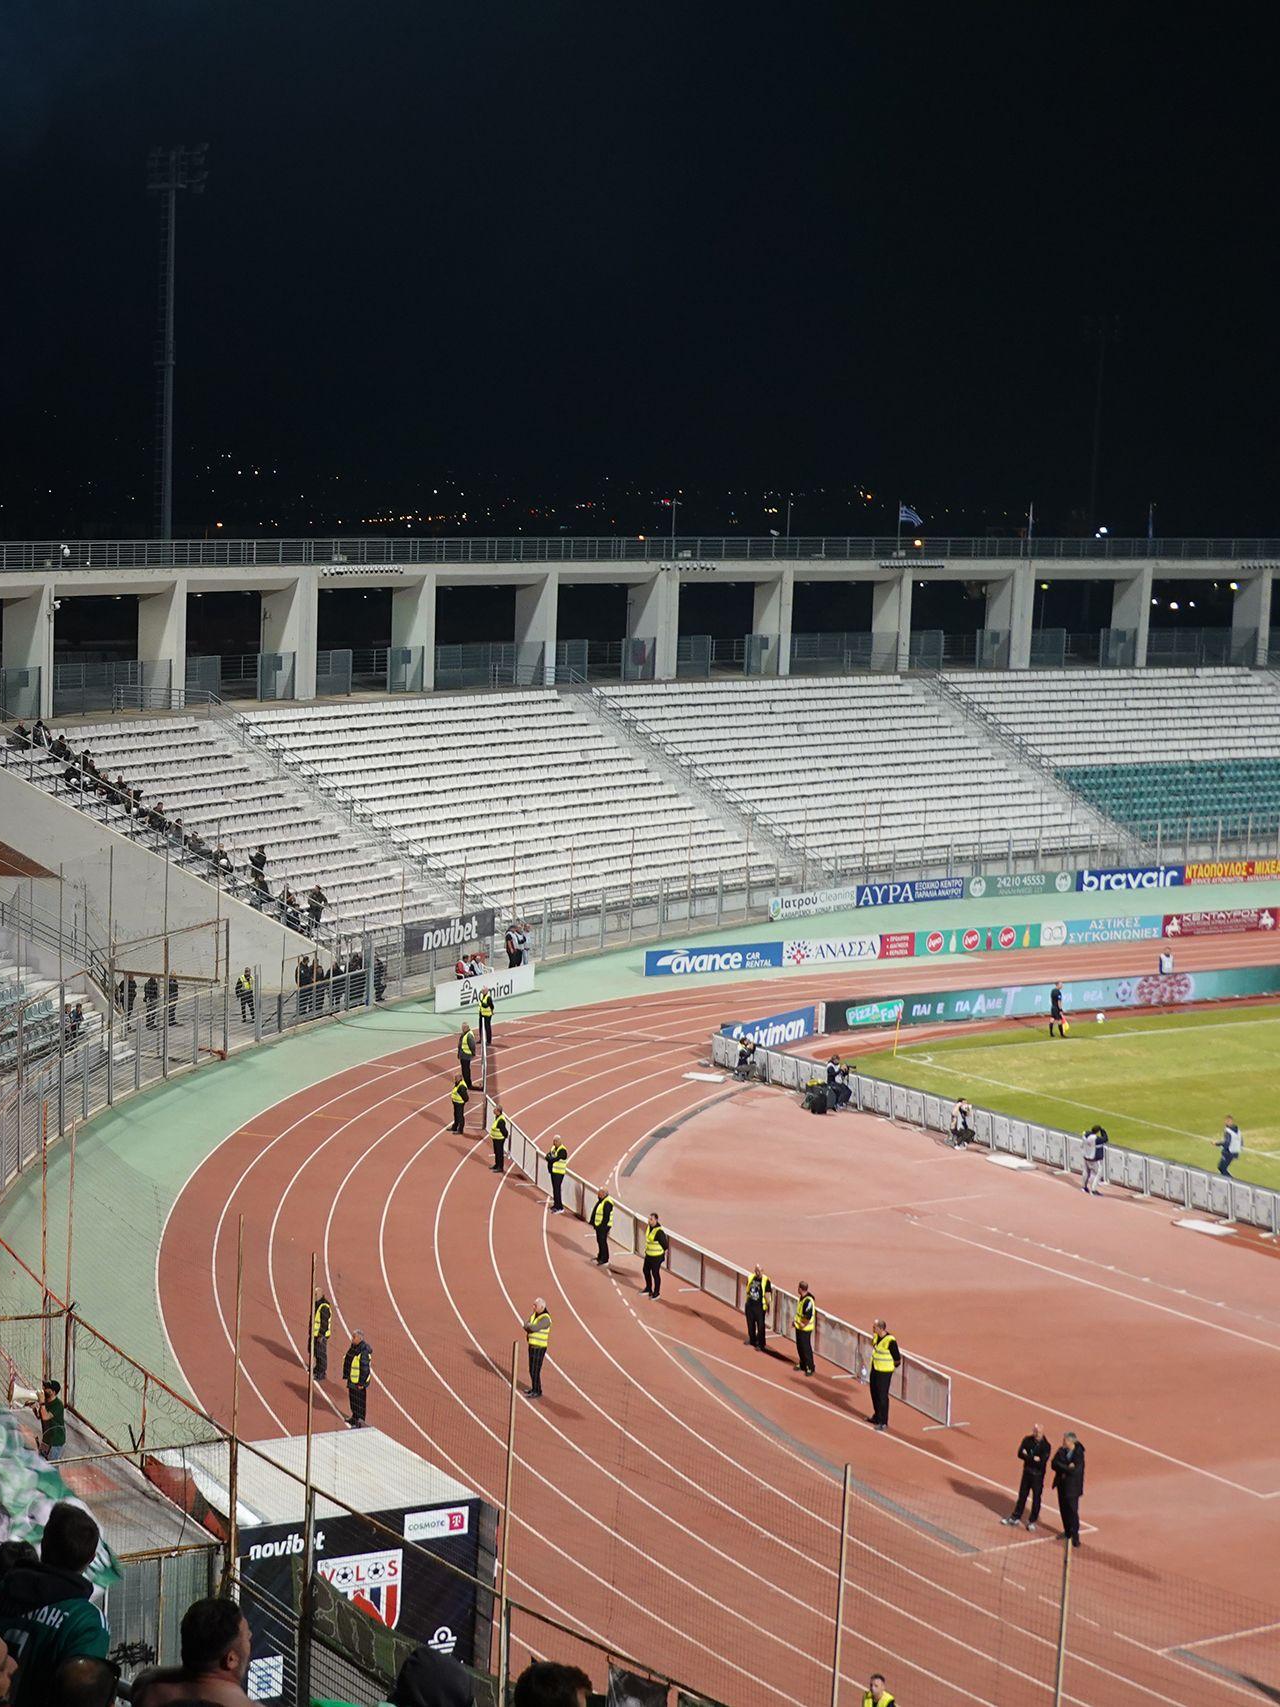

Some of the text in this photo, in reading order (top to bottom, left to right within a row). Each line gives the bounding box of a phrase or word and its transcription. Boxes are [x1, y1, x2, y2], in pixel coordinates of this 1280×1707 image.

[940, 878, 963, 888] ΚΕΝΤΡΟ
[997, 876, 1020, 888] 24210
[1082, 865, 1178, 891] bravair
[780, 890, 855, 909] Ιατρού Cleaning
[859, 882, 914, 906] ΑΥΡΑ
[1089, 917, 1140, 930] ΑΣΤΙΚΕΣ
[1182, 909, 1258, 922] ΚΕΝΤΑΥΡΟΣ
[422, 915, 478, 951] novibet
[1069, 928, 1159, 943] ΣΥΓΚΟΙΝΩΝΙΕΣ
[671, 952, 743, 974] avance
[745, 959, 773, 969] RENTAL
[746, 951, 761, 960] CAR
[471, 979, 513, 1004] Amiral
[732, 1018, 805, 1047] Soiximan
[249, 1531, 326, 1560] novibt
